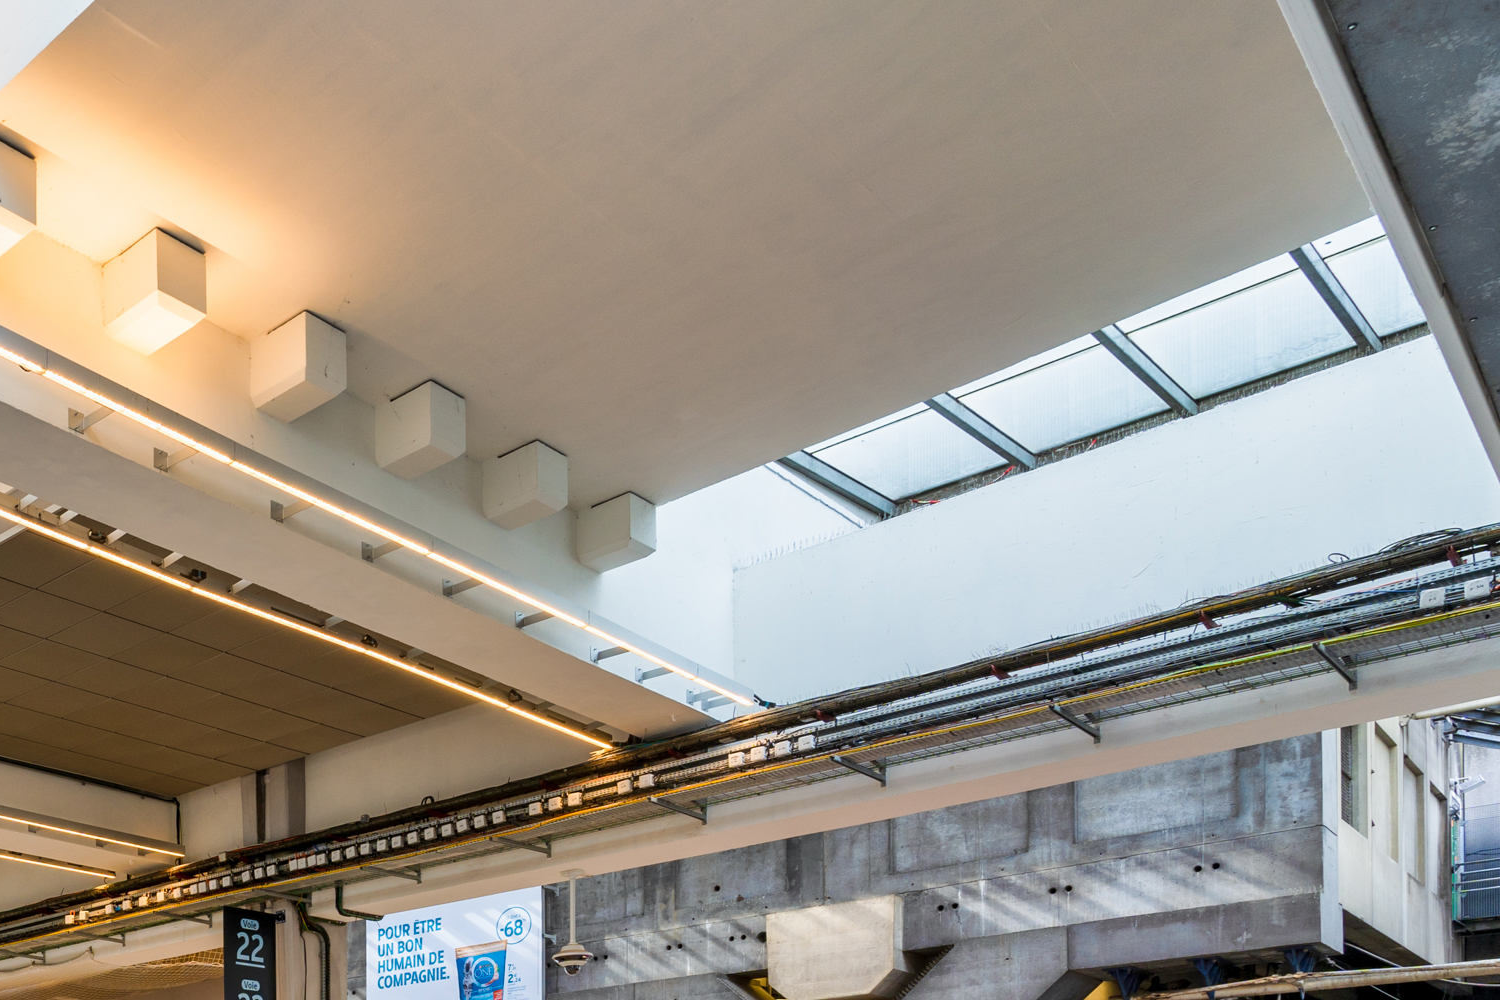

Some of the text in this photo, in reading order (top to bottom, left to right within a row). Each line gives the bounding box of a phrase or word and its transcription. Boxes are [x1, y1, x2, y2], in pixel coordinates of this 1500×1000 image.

[243, 920, 257, 929] Voie
[377, 917, 442, 942] POUR ÊTRE
[237, 932, 264, 963] 22
[377, 938, 423, 958] UN BON
[377, 950, 445, 974] HUMAIN DE
[377, 967, 450, 990] COMPAGNIE.
[474, 967, 494, 979] ONE
[244, 981, 258, 990] Voie
